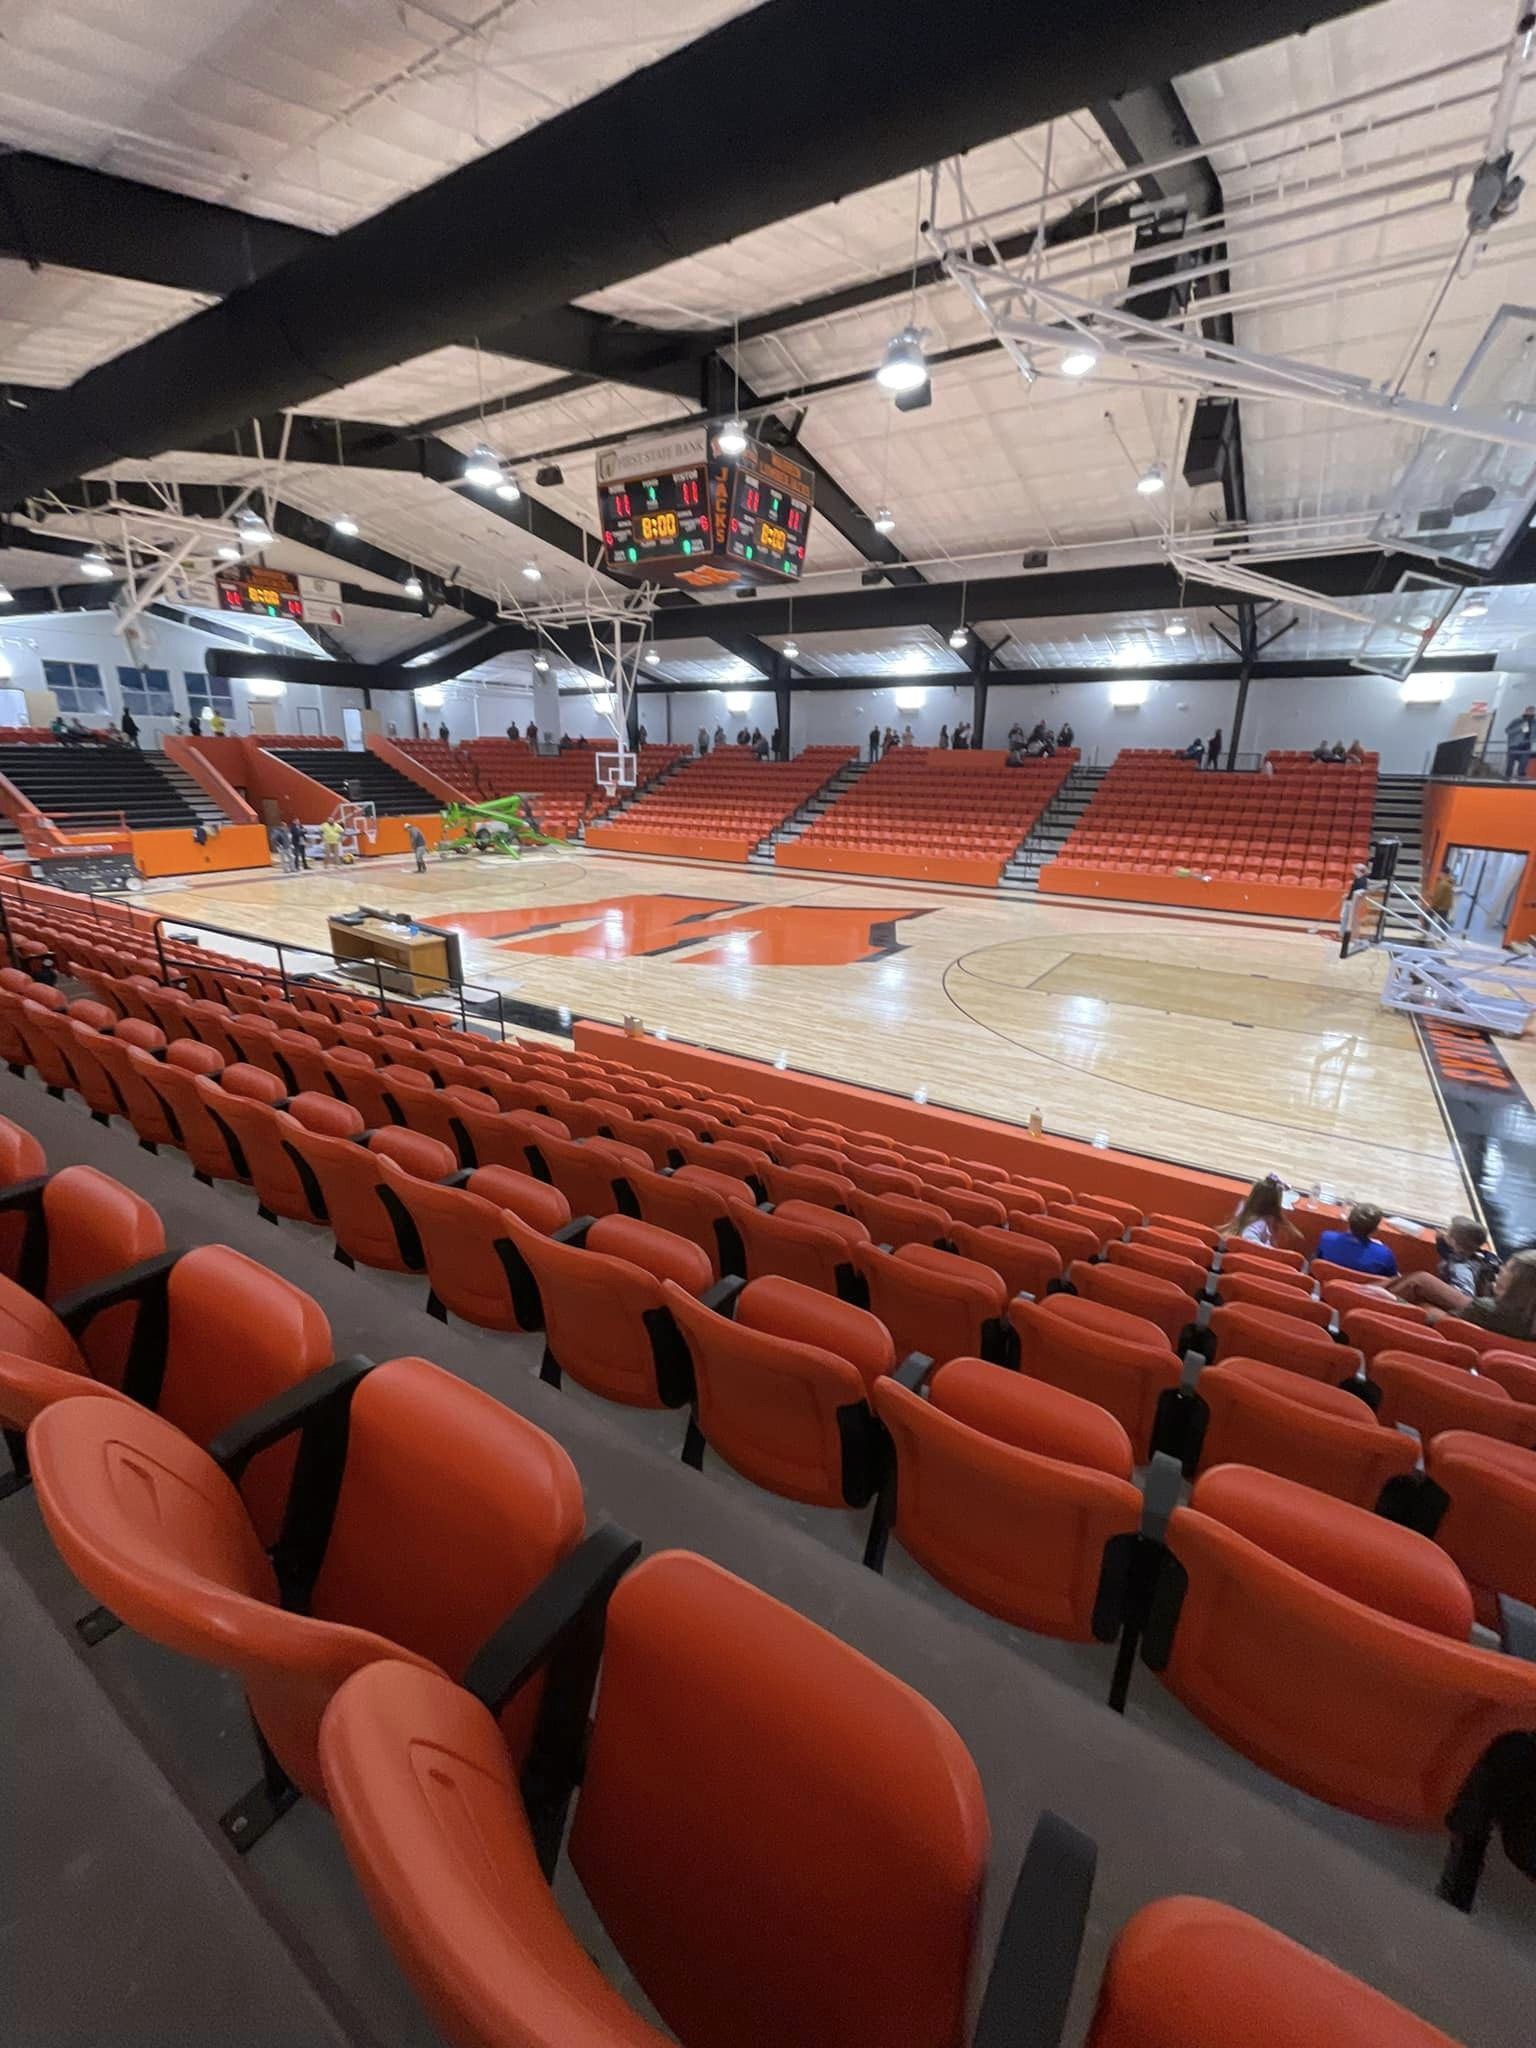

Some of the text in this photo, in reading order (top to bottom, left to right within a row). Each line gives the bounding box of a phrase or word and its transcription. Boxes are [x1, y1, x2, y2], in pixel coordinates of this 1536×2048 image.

[676, 439, 704, 458] BANK
[683, 481, 698, 504] 11
[616, 495, 630, 516] 11
[714, 466, 729, 544] JACKS
